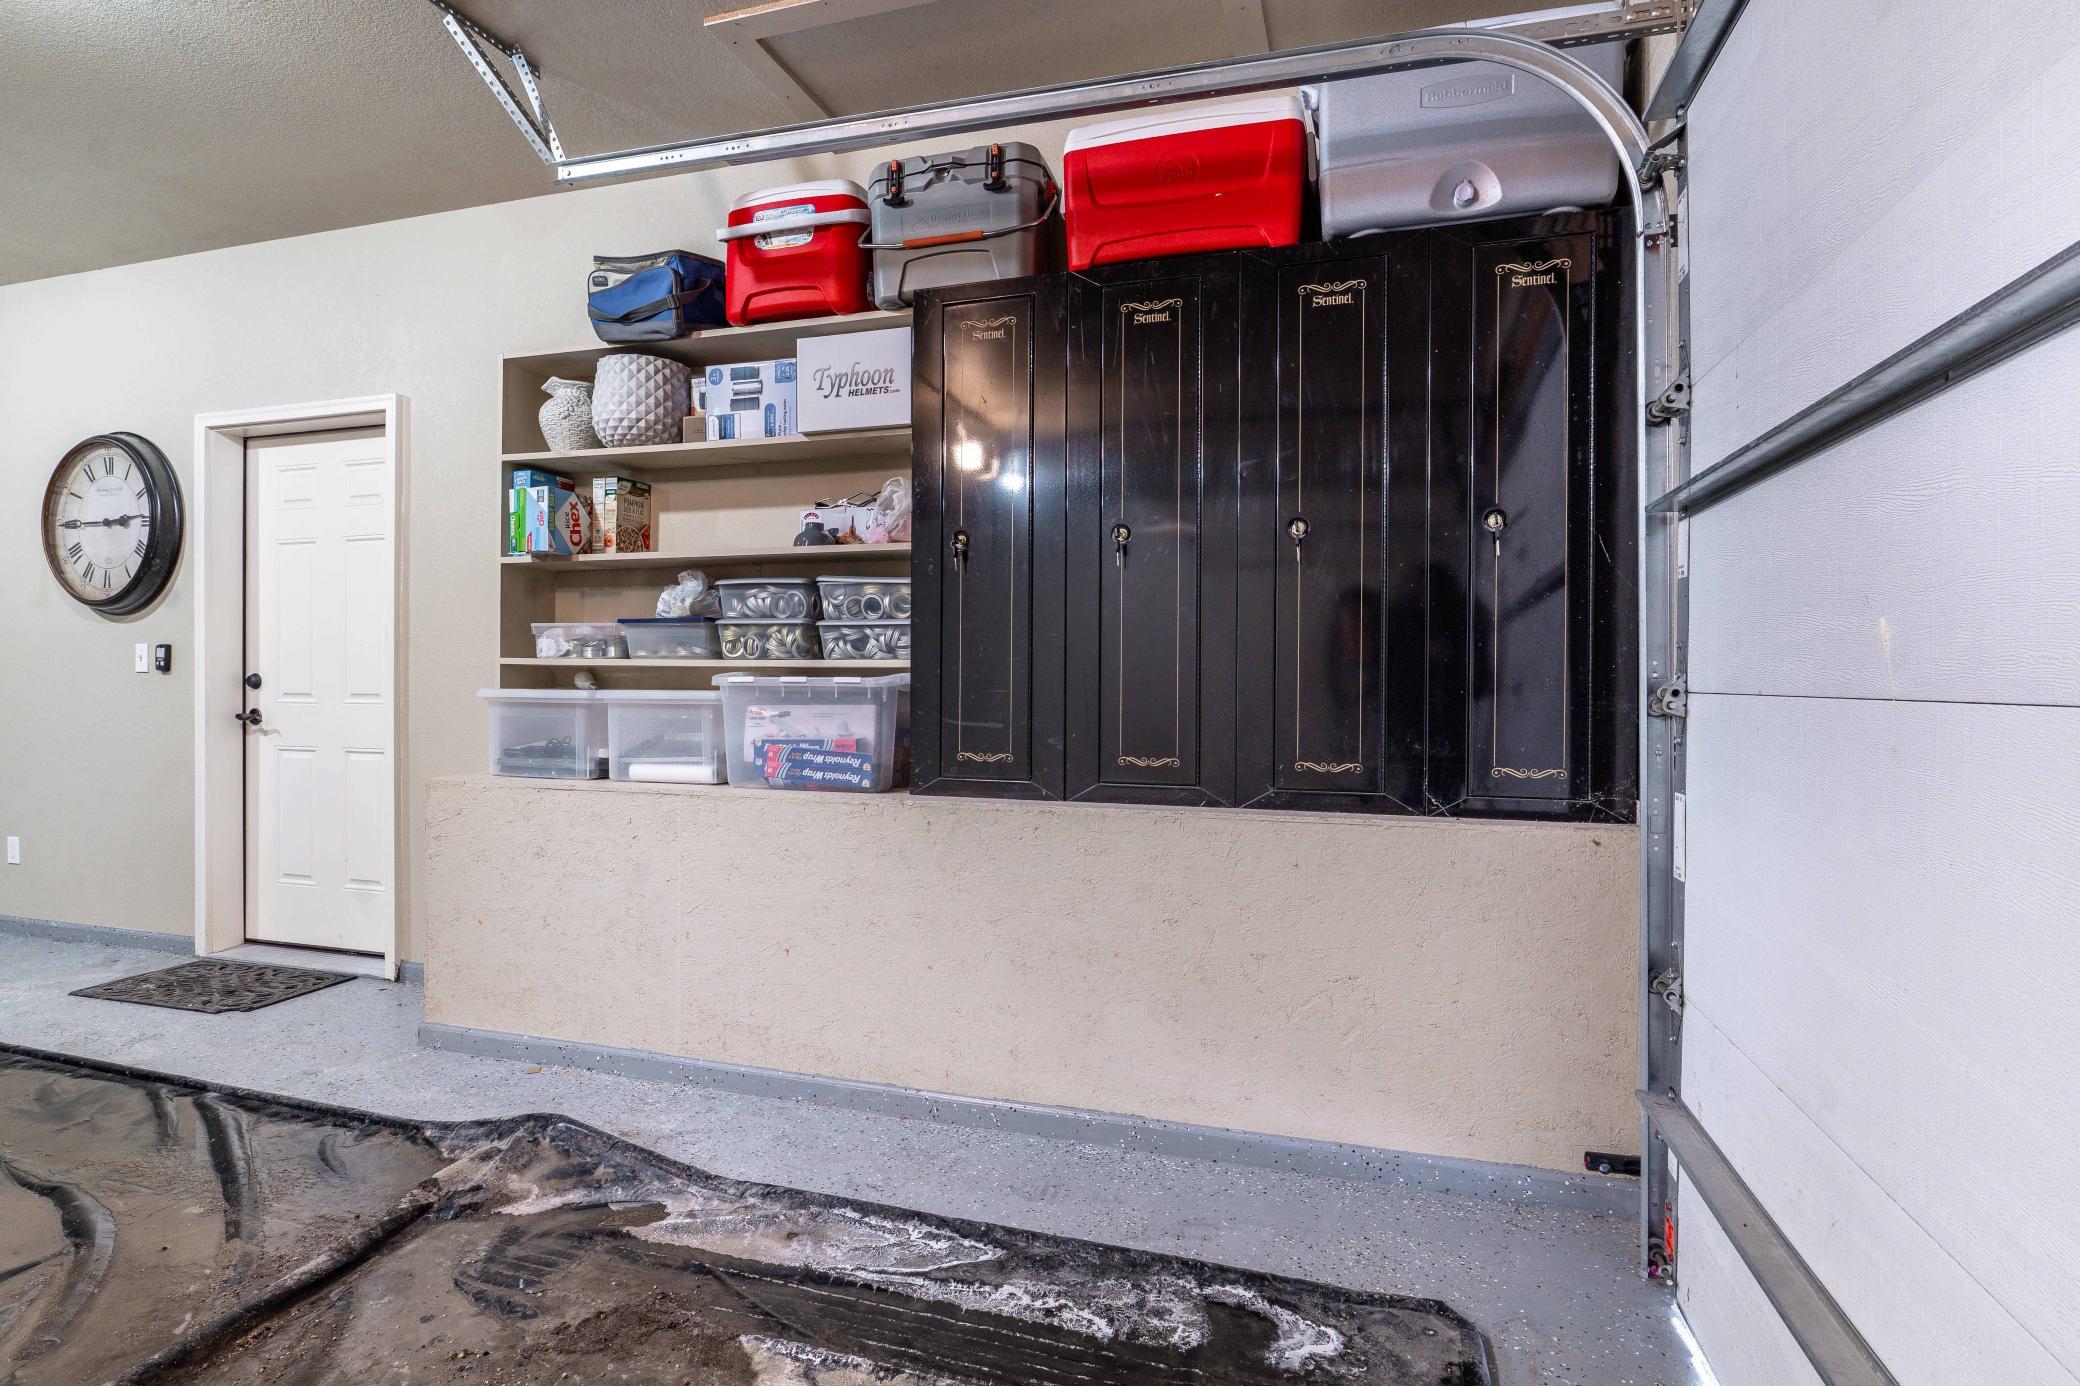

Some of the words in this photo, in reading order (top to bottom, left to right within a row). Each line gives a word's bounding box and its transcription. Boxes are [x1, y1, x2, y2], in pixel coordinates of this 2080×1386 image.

[813, 361, 894, 399] Typhoon
[569, 501, 583, 547] Chex
[802, 751, 825, 764] Wrap
[823, 754, 861, 768] Reynolds
[802, 767, 824, 780] Wrap
[823, 770, 860, 783] Reynolds
